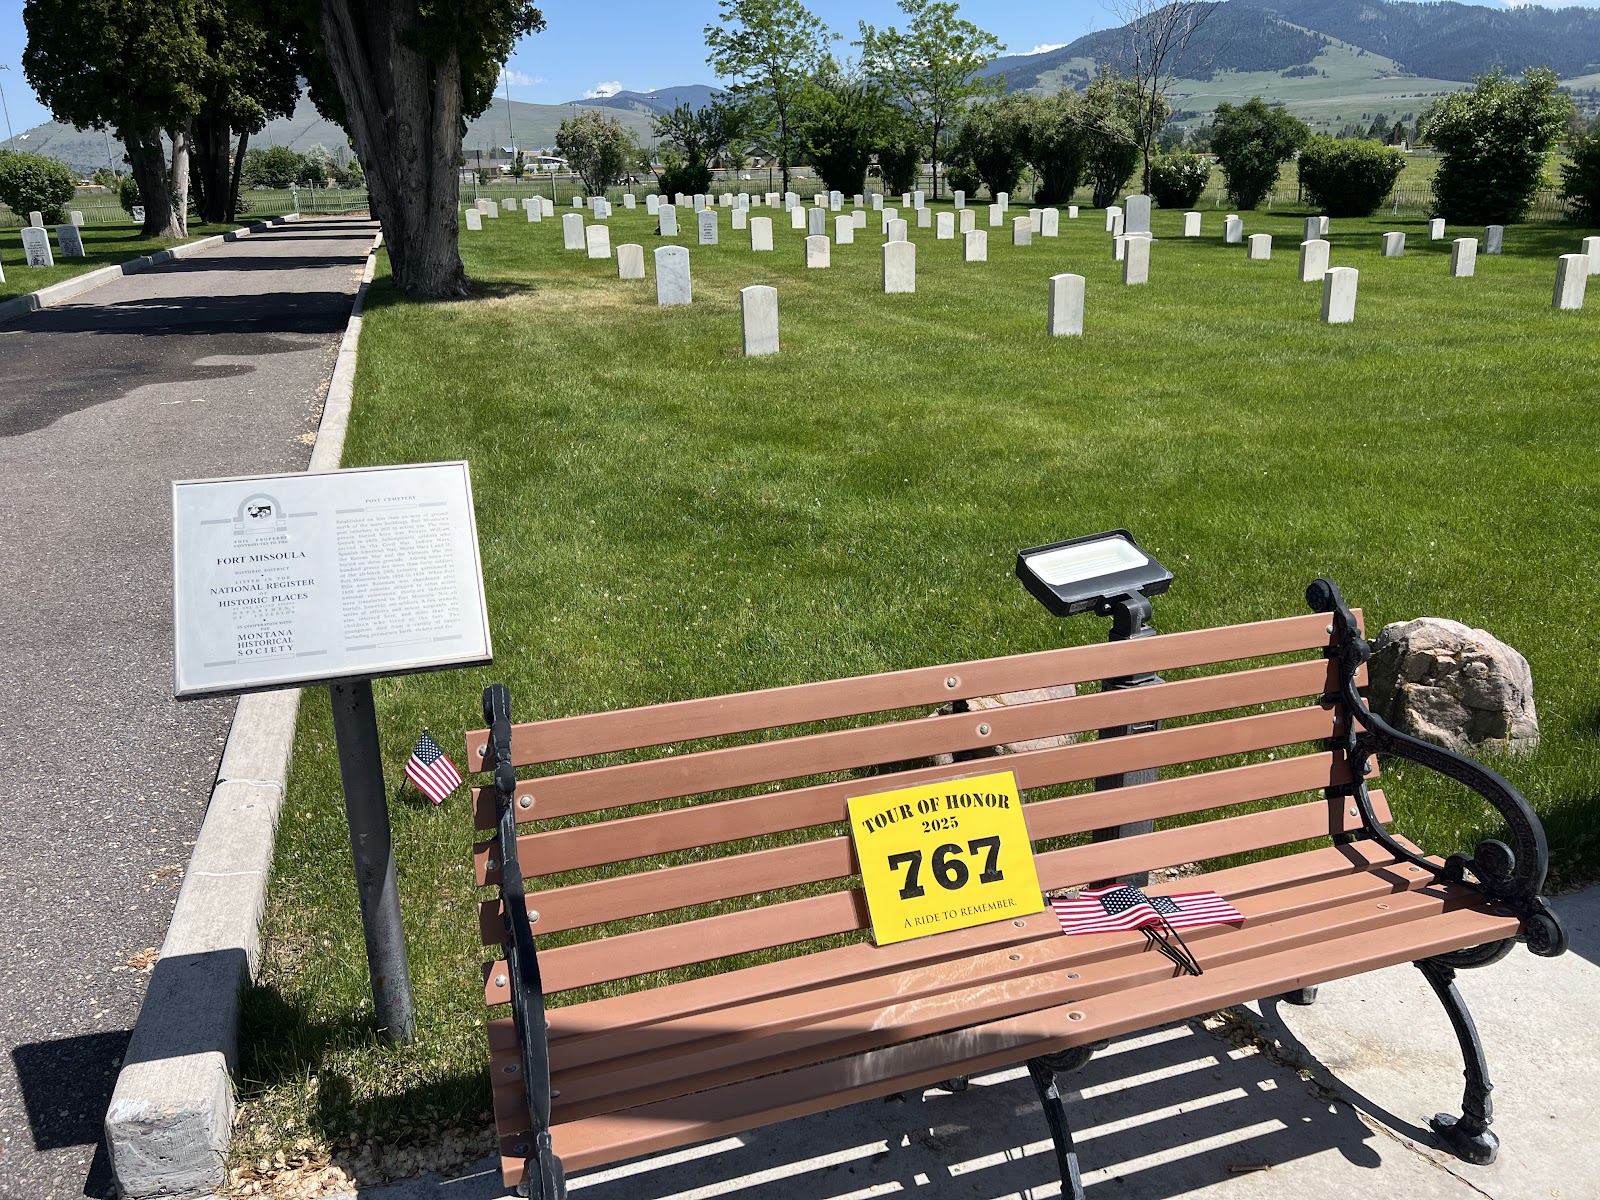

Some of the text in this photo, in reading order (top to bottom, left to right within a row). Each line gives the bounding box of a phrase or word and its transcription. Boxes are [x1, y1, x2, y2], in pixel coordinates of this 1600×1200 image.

[217, 551, 306, 566] FORT MISSOULA
[210, 579, 315, 595] NATIONAL REGISTER
[219, 593, 308, 608] HISTORIC PLACES
[237, 629, 293, 641] MONTANA
[238, 636, 294, 649] HISTORICAL
[238, 644, 294, 657] SOCIETY
[862, 793, 1010, 834] TOUR OF HONOR
[922, 816, 959, 834] 2025
[888, 836, 1004, 900] 767
[904, 898, 1018, 928] A RIDE TO REMEMBER.
